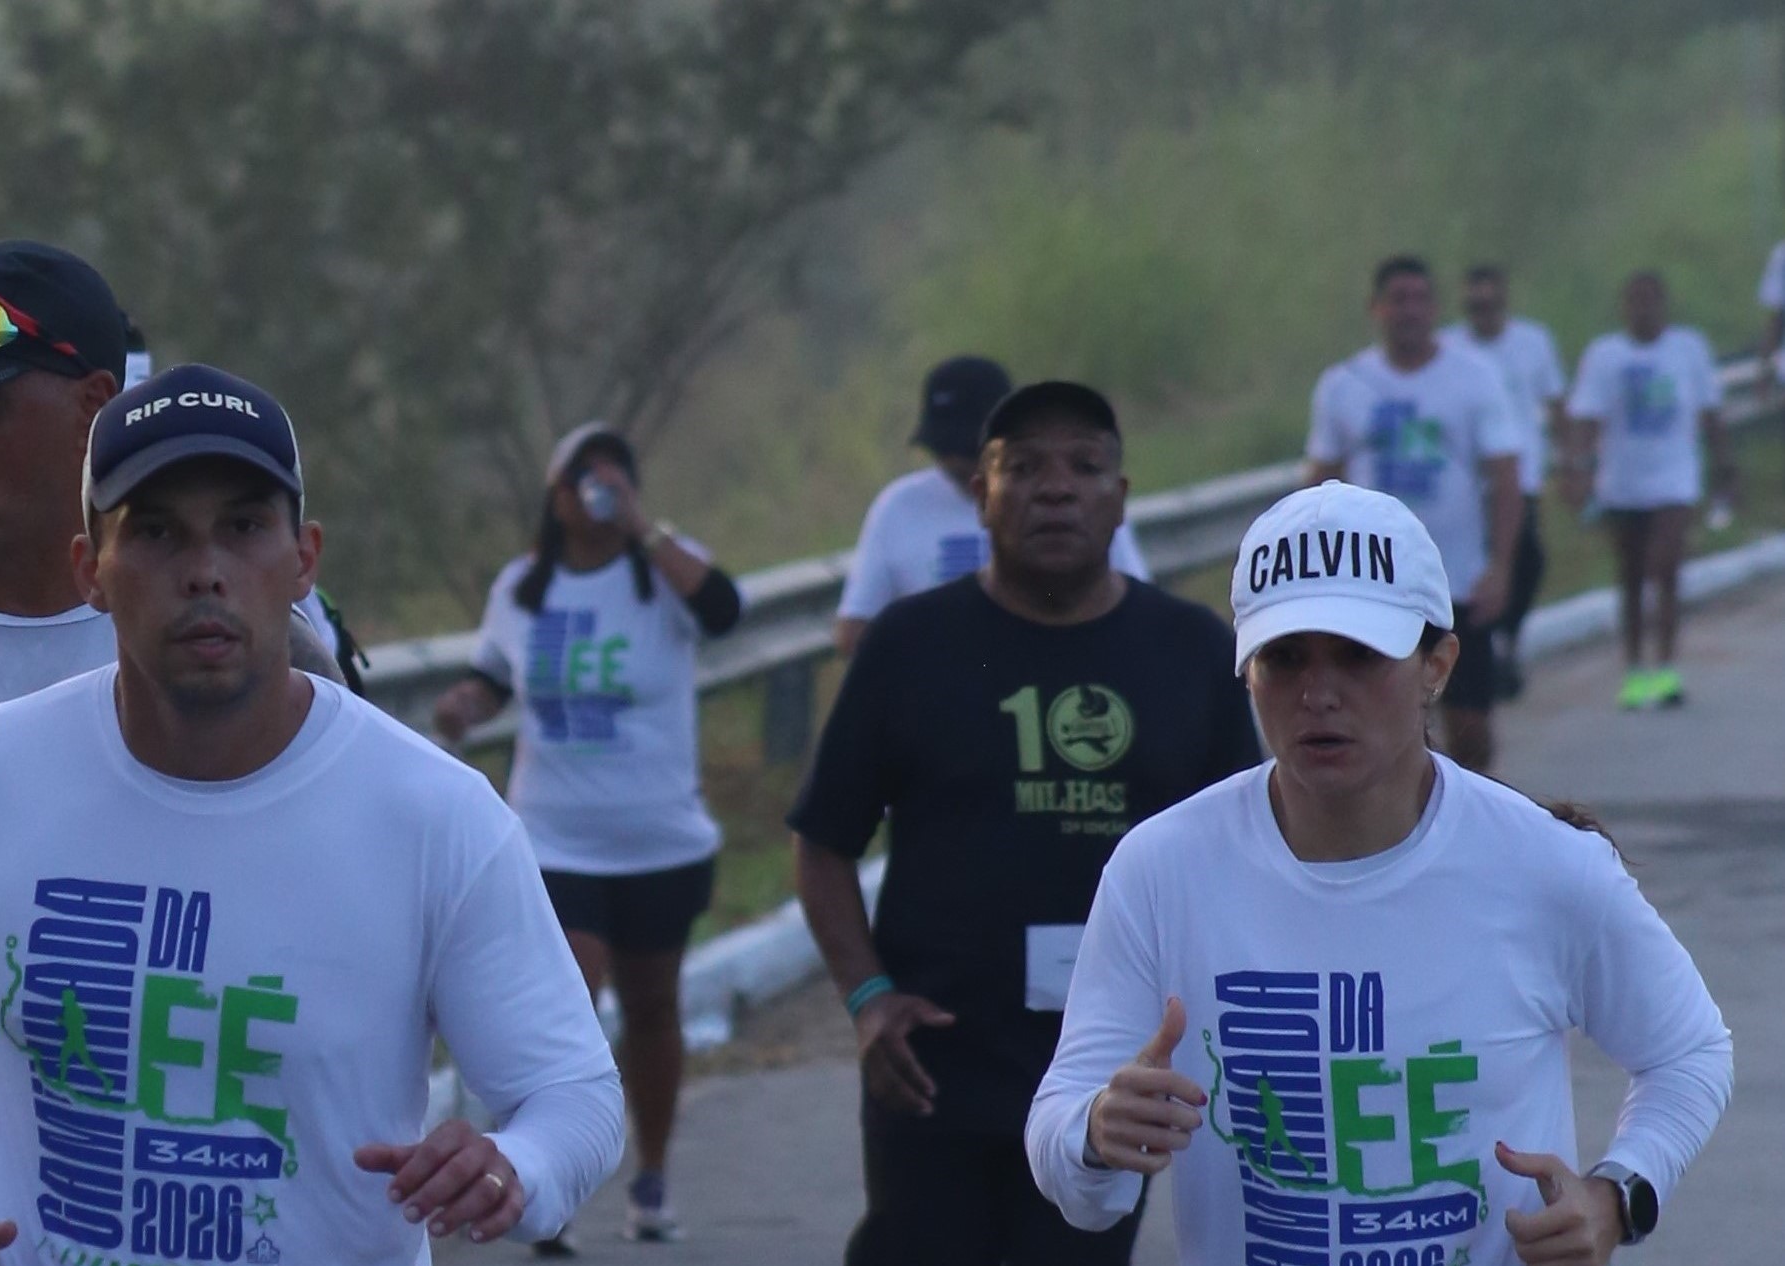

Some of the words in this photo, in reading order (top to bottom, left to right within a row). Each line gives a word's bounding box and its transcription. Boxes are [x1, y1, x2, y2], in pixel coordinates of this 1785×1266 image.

[125, 397, 172, 427] RIP
[177, 392, 260, 419] CURL
[1250, 530, 1395, 593] CALVIN
[1015, 780, 1126, 813] MILHAS
[147, 887, 212, 973] DA
[1329, 971, 1385, 1053] DA
[136, 974, 299, 1135] FÉ
[1330, 1039, 1480, 1193] FÉ
[147, 1139, 269, 1170] 34KM
[131, 1177, 244, 1263] 2026
[1352, 1206, 1469, 1235] 34KM
